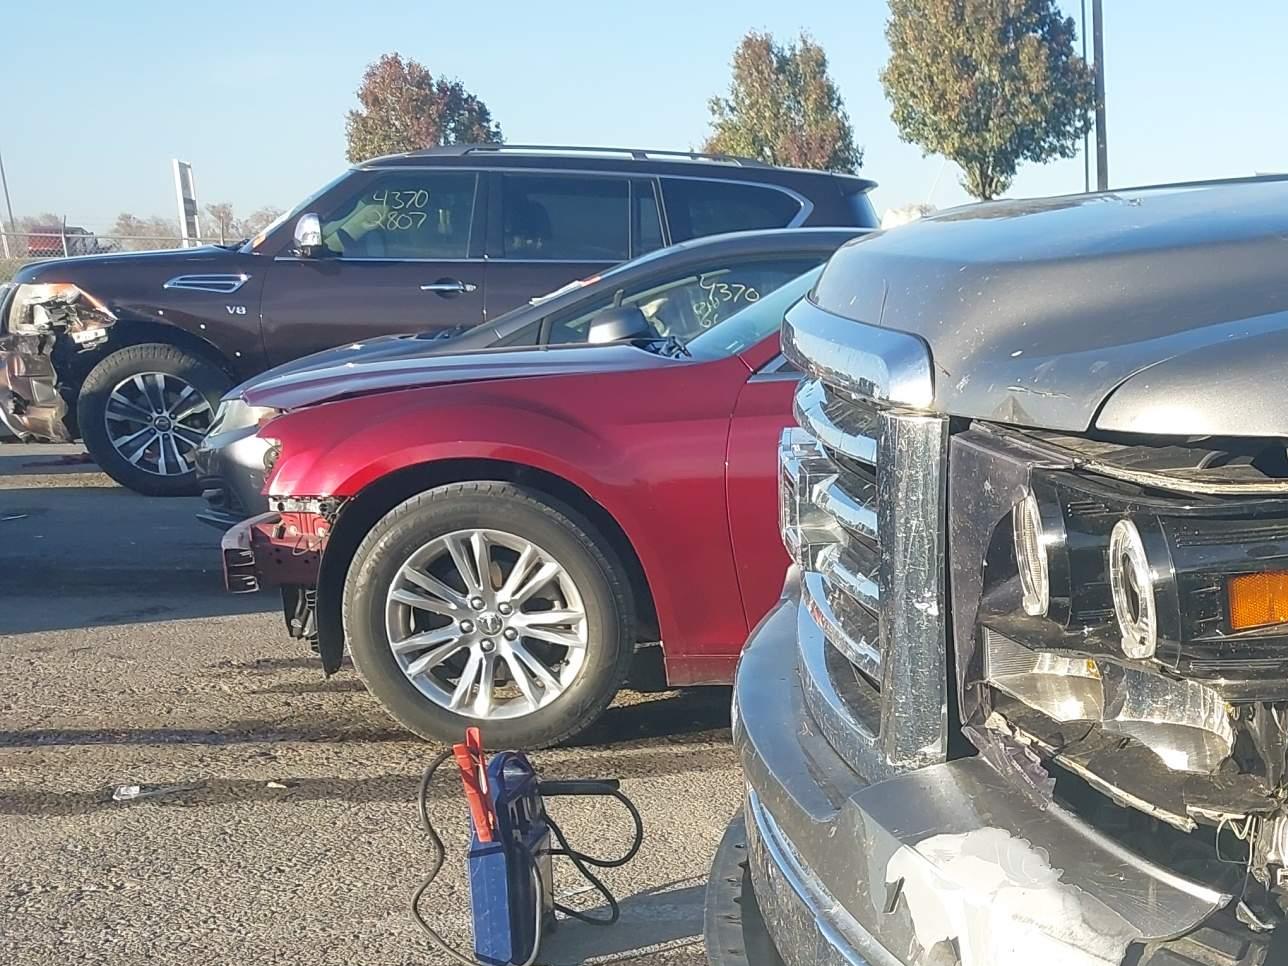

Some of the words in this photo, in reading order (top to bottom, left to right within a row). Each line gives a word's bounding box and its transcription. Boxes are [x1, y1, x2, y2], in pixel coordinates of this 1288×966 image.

[372, 189, 429, 209] 4370
[699, 275, 760, 302] 4370
[225, 305, 247, 315] V8
